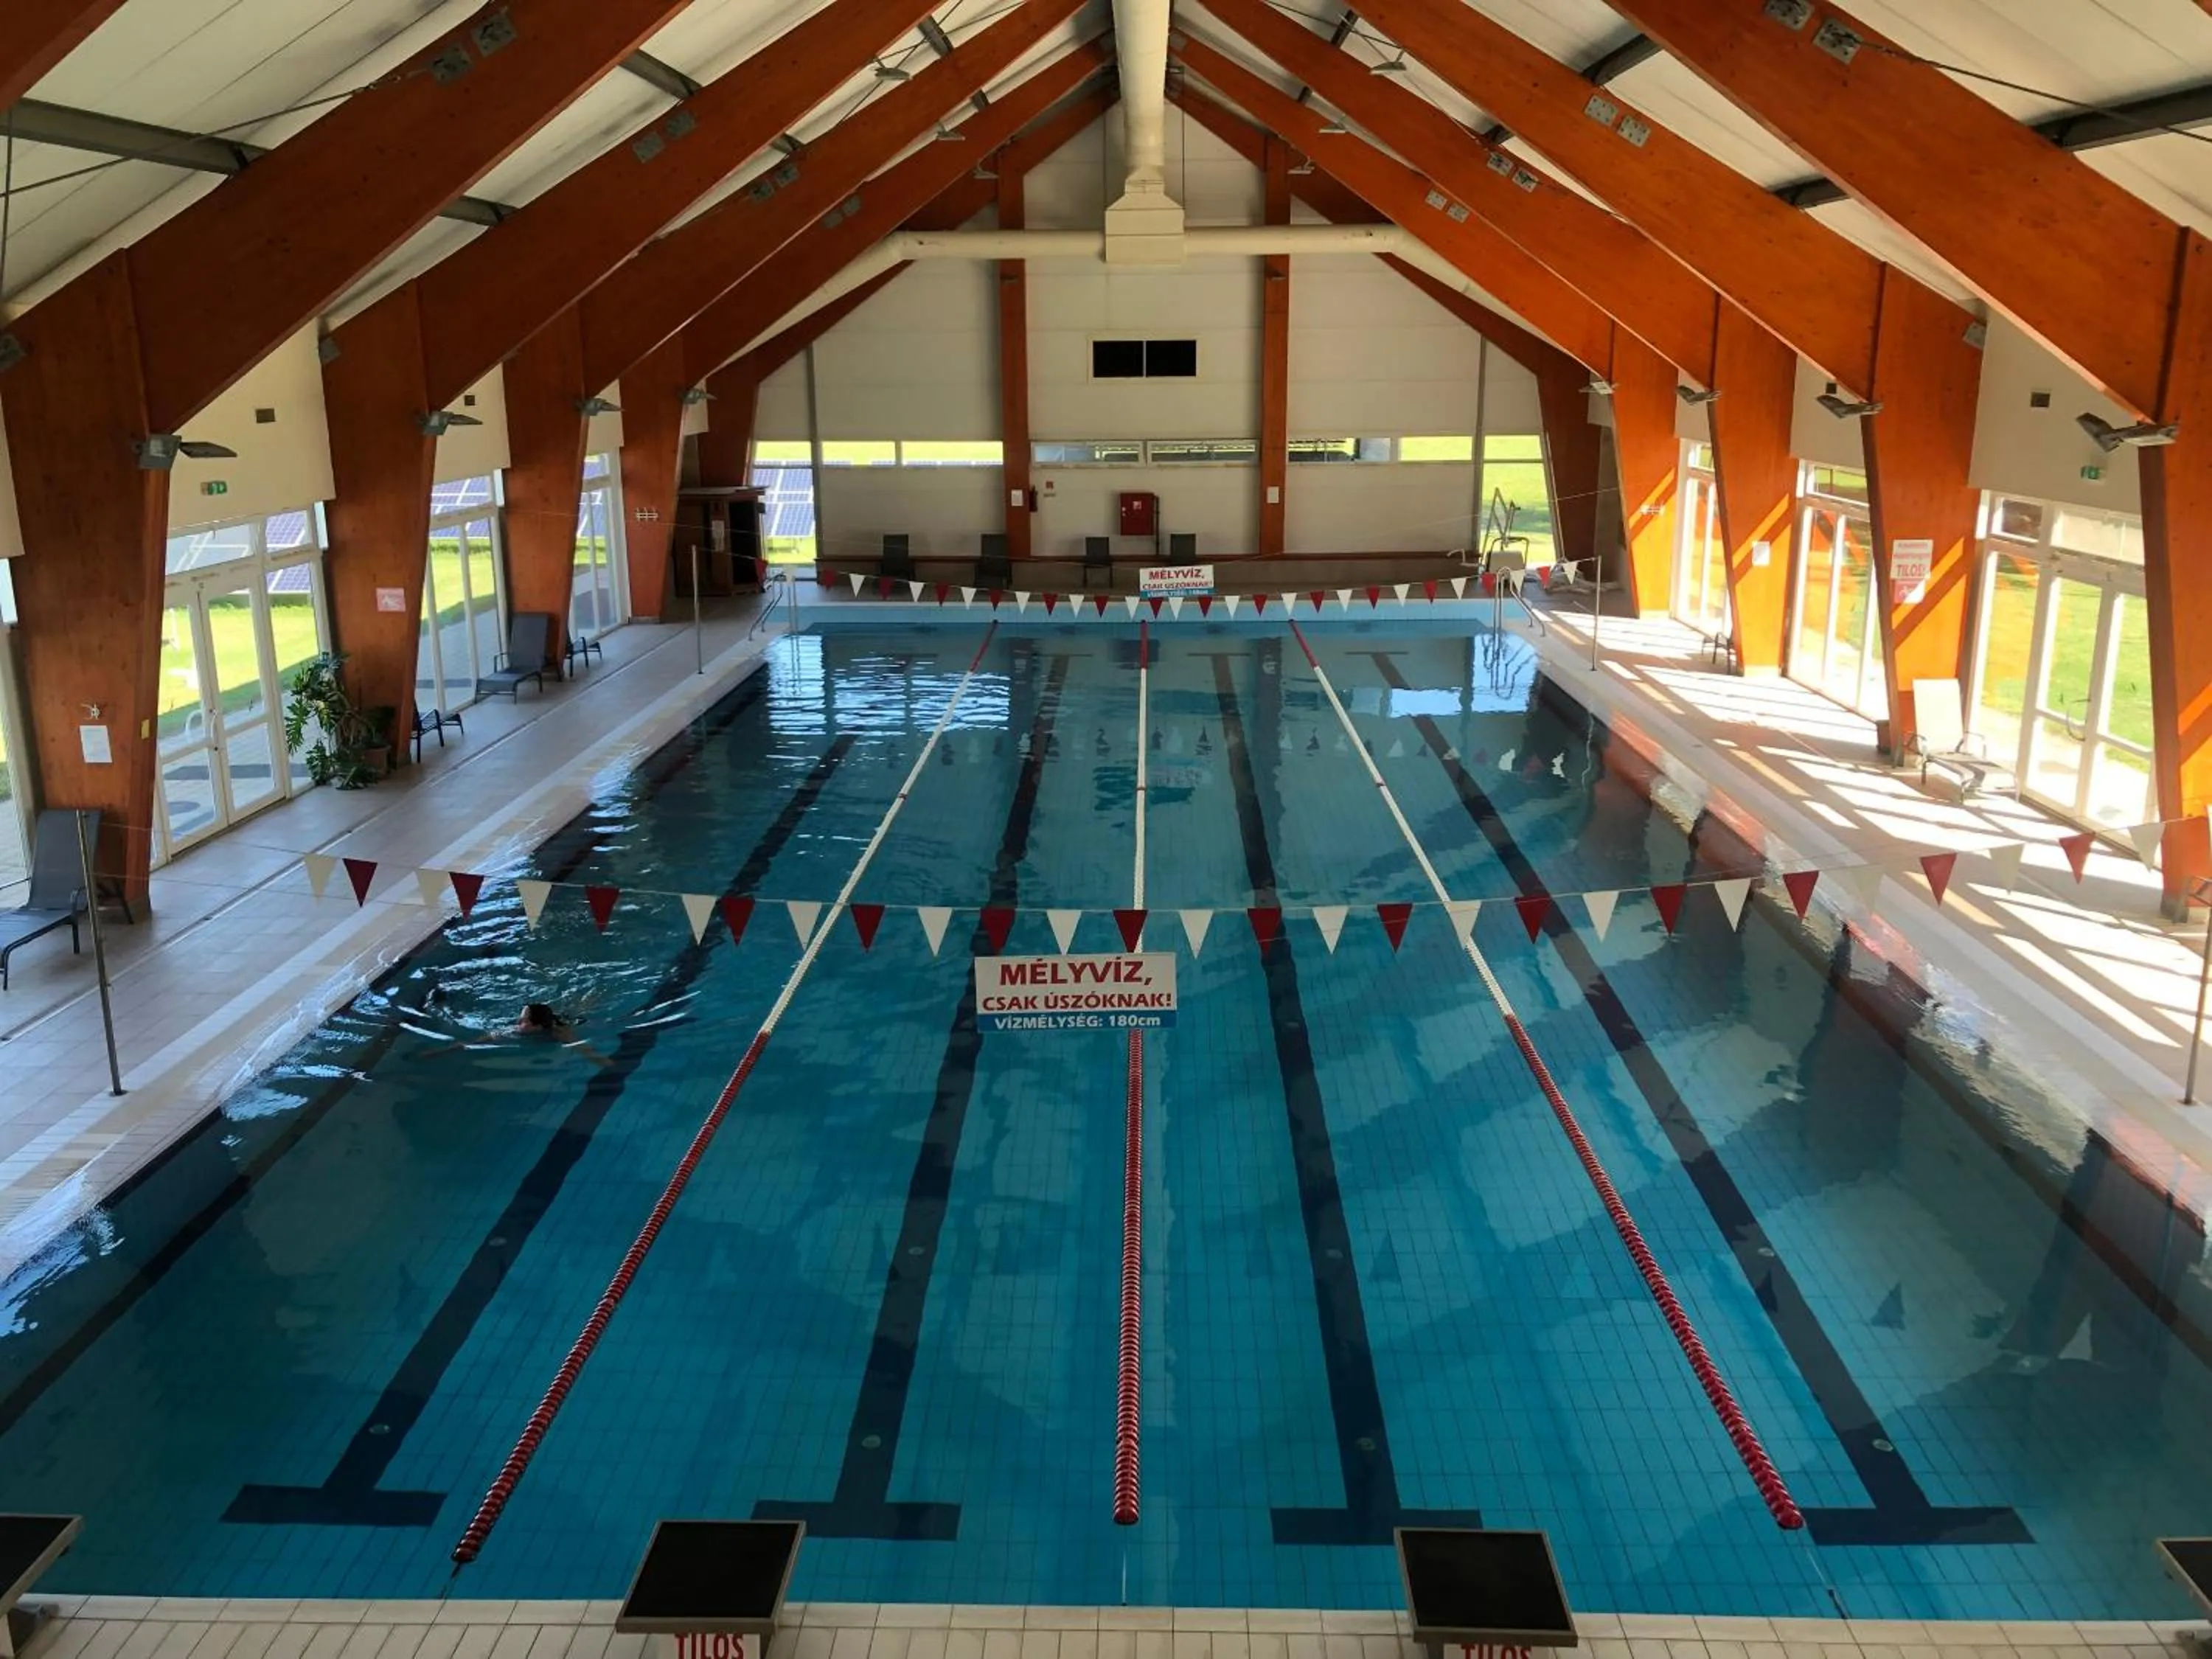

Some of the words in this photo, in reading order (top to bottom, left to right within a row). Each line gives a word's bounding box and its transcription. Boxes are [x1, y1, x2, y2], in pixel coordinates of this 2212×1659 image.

[1000, 956, 1152, 986] MÉLYVÍZ,
[982, 996, 1038, 1011] CSAK
[1043, 991, 1172, 1009] ÚSZÓKNAK!
[994, 1013, 1104, 1029] VÍZMÉLYSÉG:
[1109, 1015, 1161, 1027] 180cm
[674, 1631, 744, 1659] TILOS
